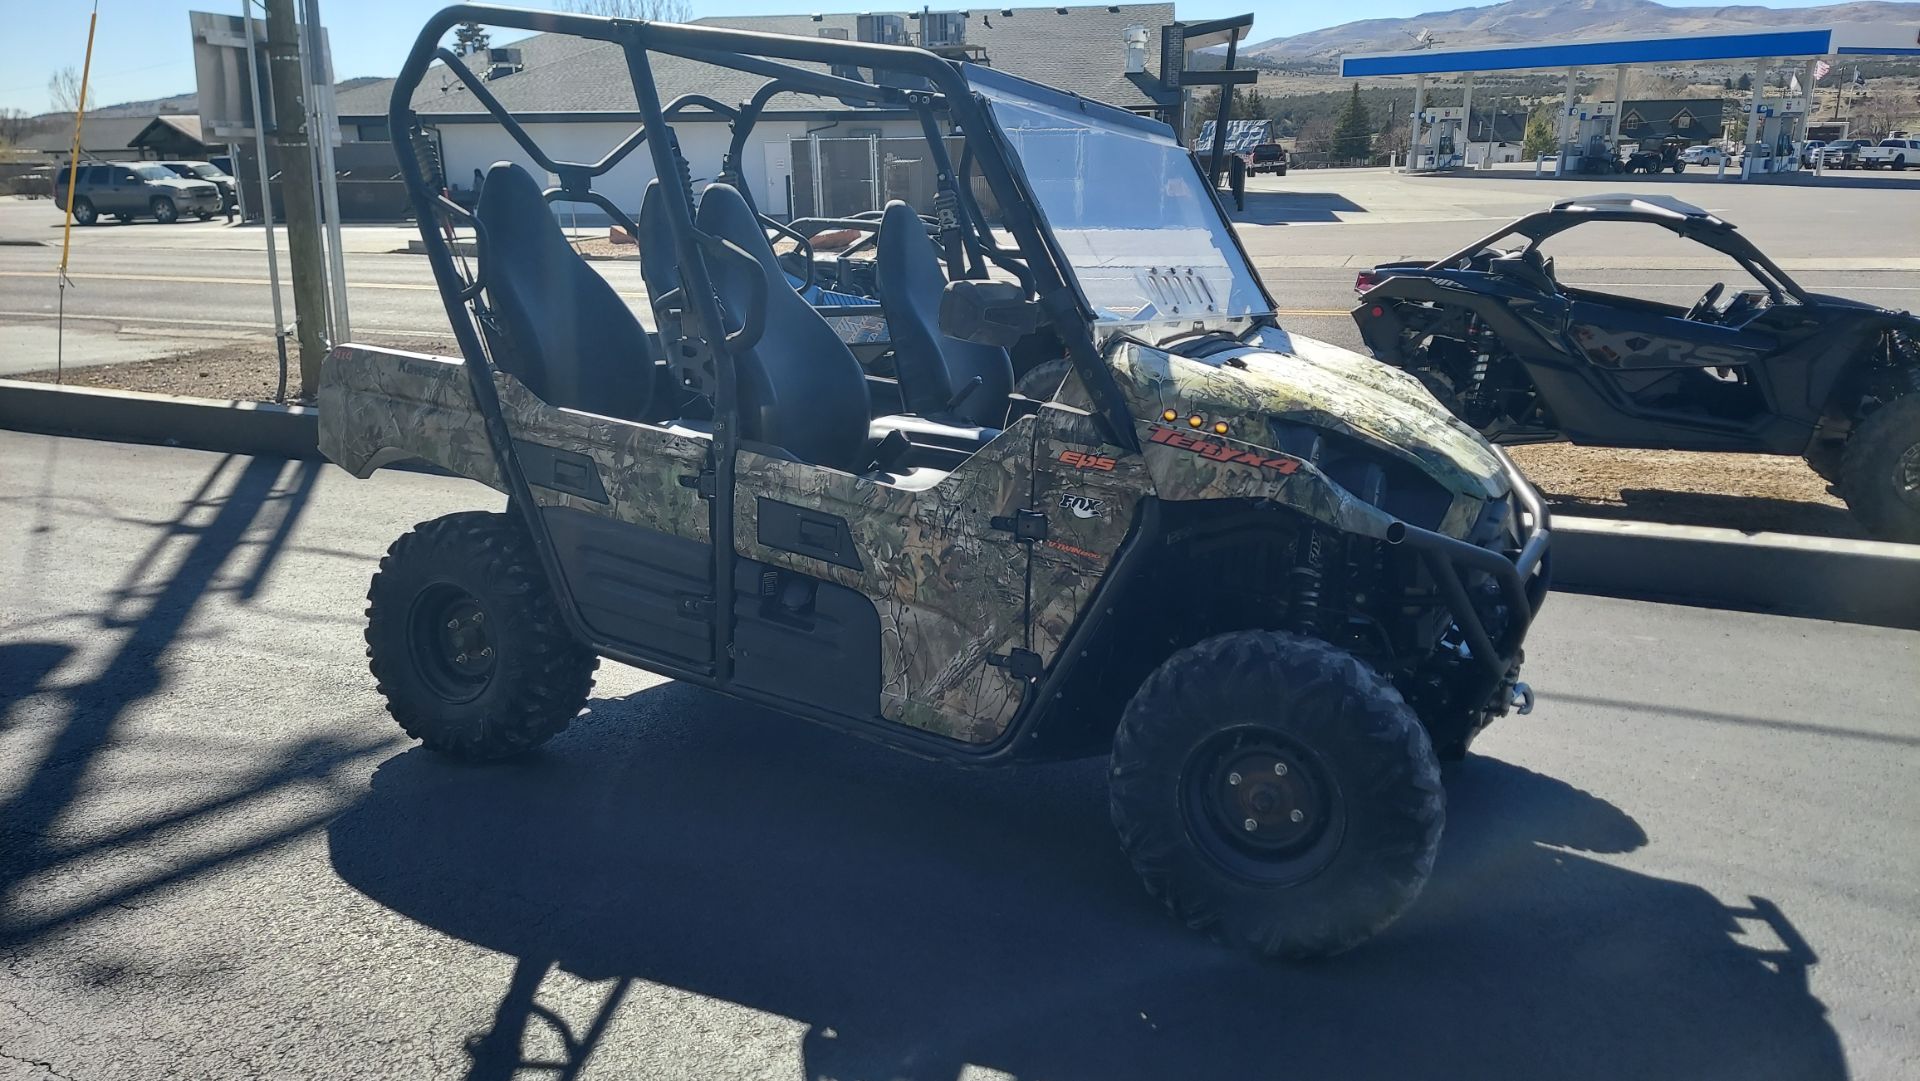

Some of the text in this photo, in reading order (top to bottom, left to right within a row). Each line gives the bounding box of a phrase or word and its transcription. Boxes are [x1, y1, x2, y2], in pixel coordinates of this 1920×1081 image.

[398, 359, 460, 383] Kawasaki
[1059, 450, 1116, 471] EPS
[1059, 494, 1104, 517] FOX
